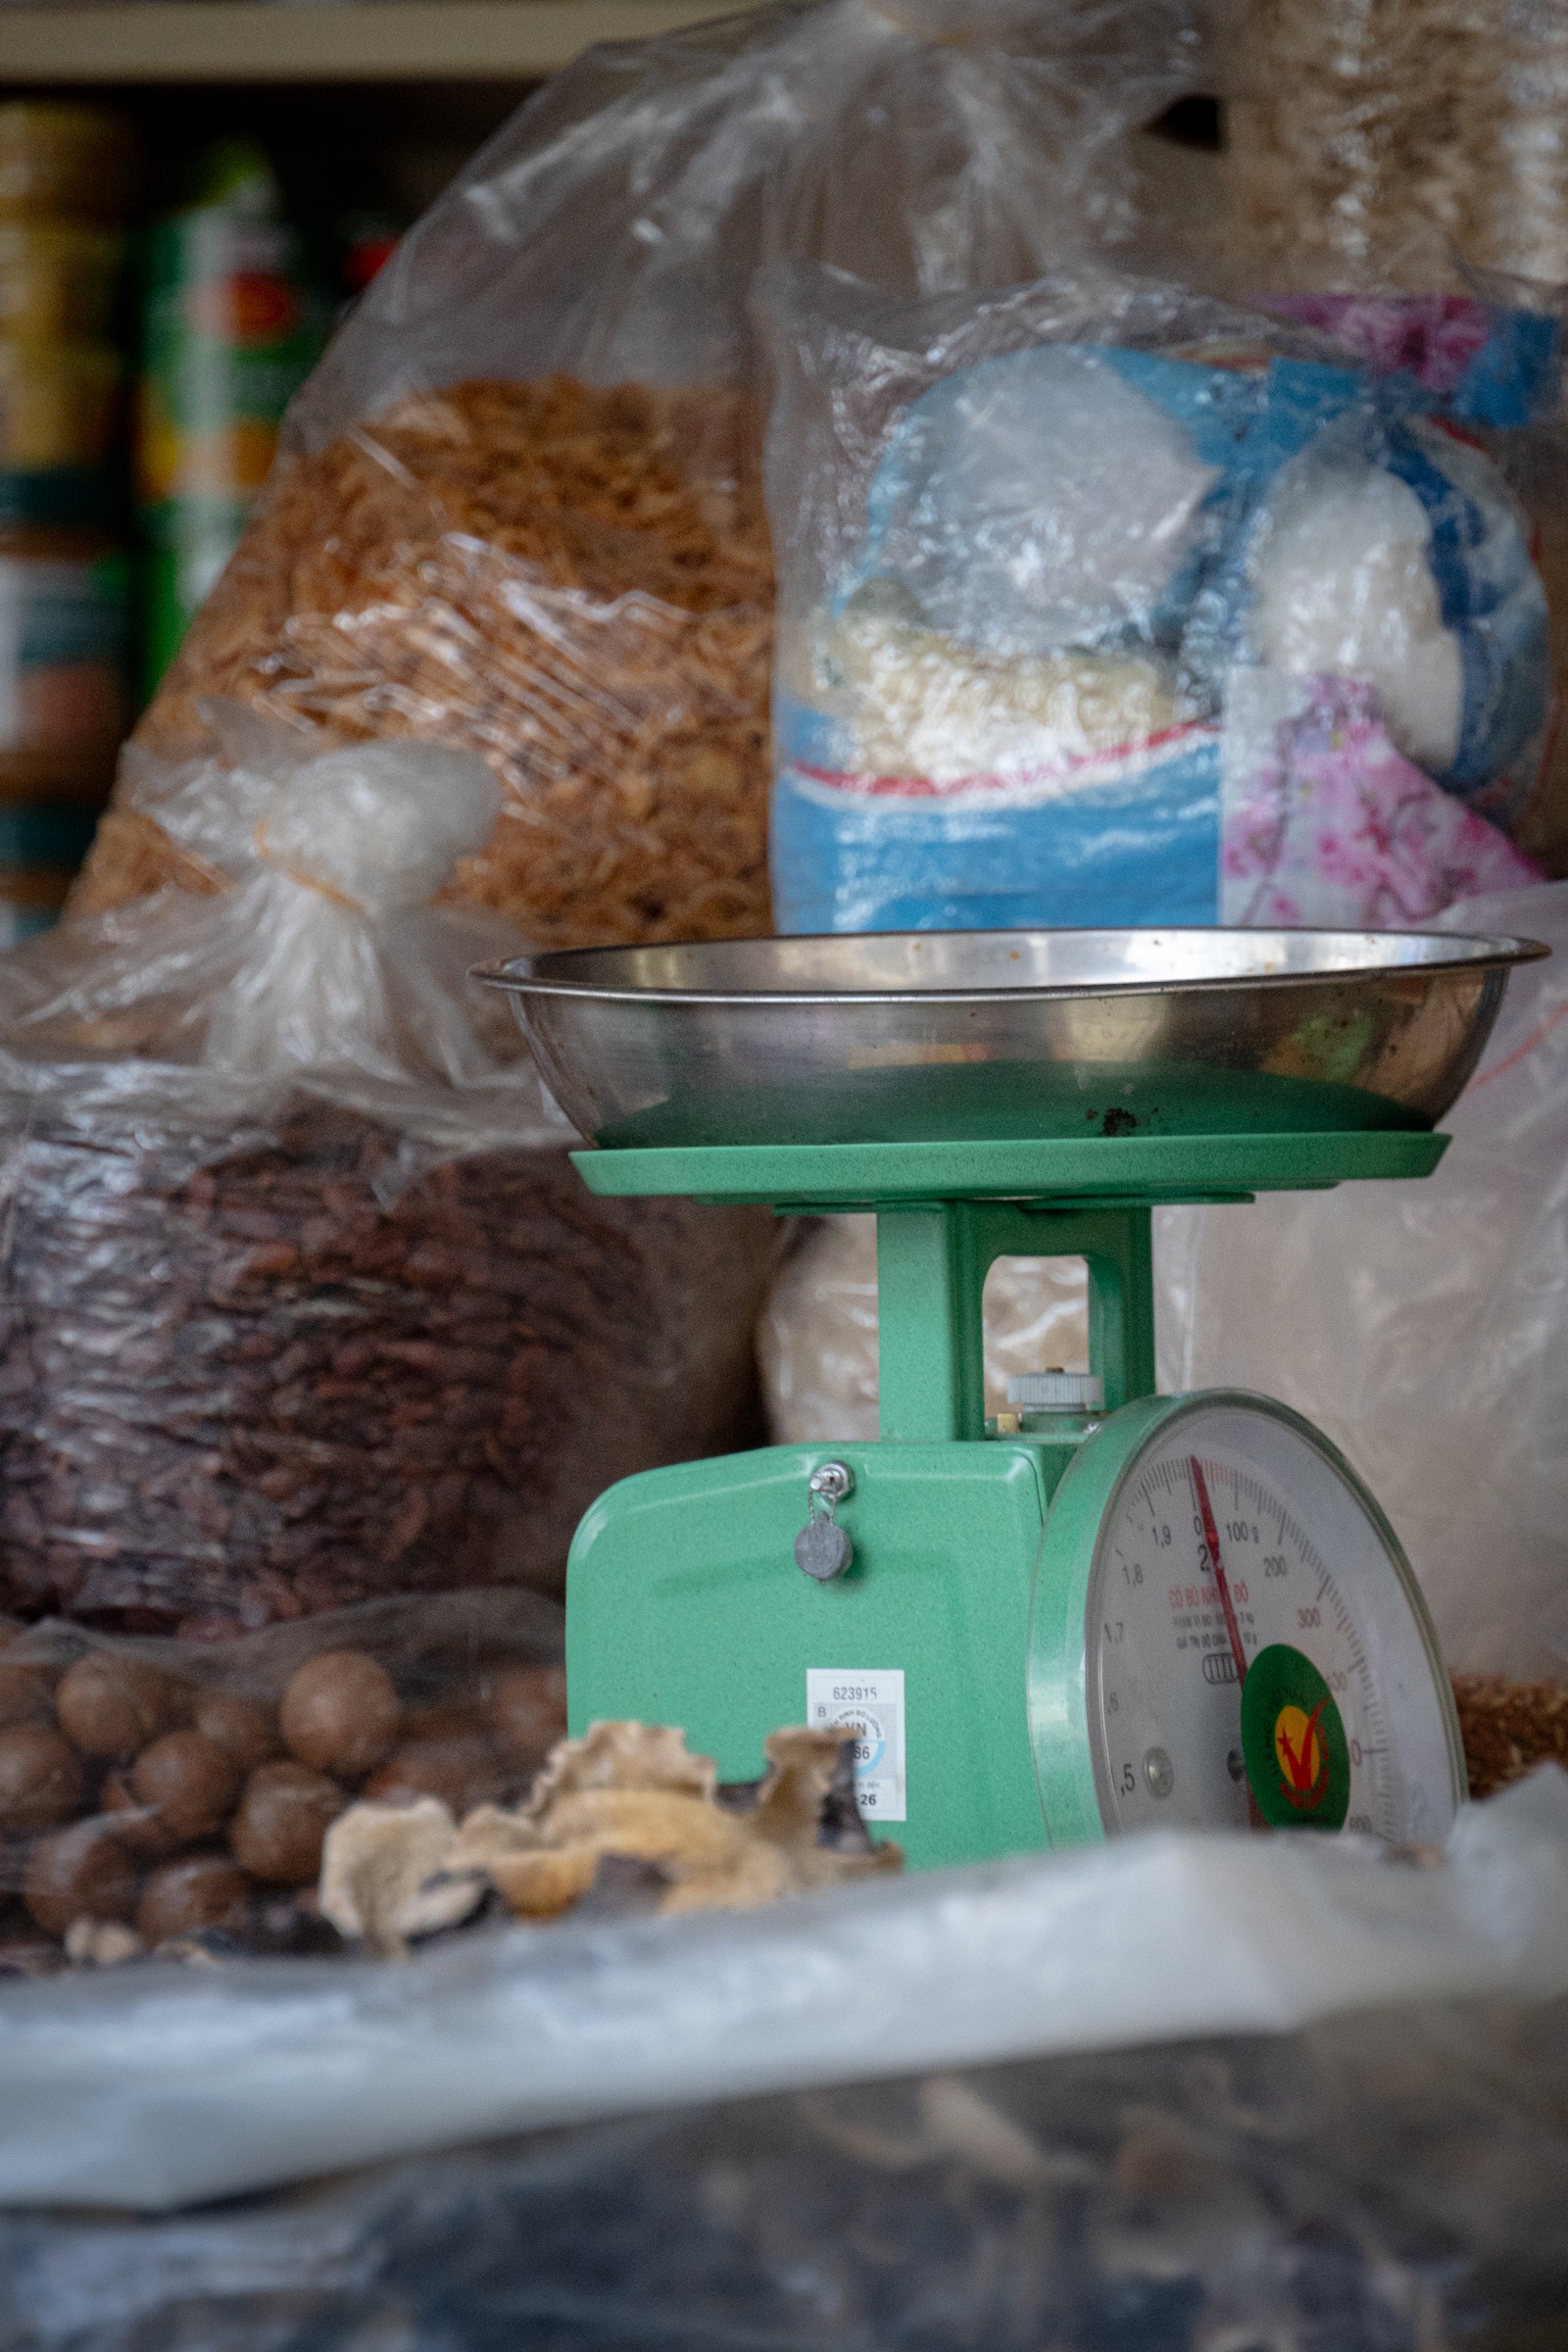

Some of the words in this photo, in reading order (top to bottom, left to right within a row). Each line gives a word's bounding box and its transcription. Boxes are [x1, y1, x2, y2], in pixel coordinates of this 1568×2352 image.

[1152, 1525, 1171, 1548] 1,9
[1226, 1521, 1249, 1544] 100
[1123, 1563, 1144, 1588] 1,8
[1263, 1554, 1288, 1578] 200
[1297, 1606, 1322, 1630] 300
[817, 1706, 827, 1718] B
[860, 1793, 877, 1806] 26
